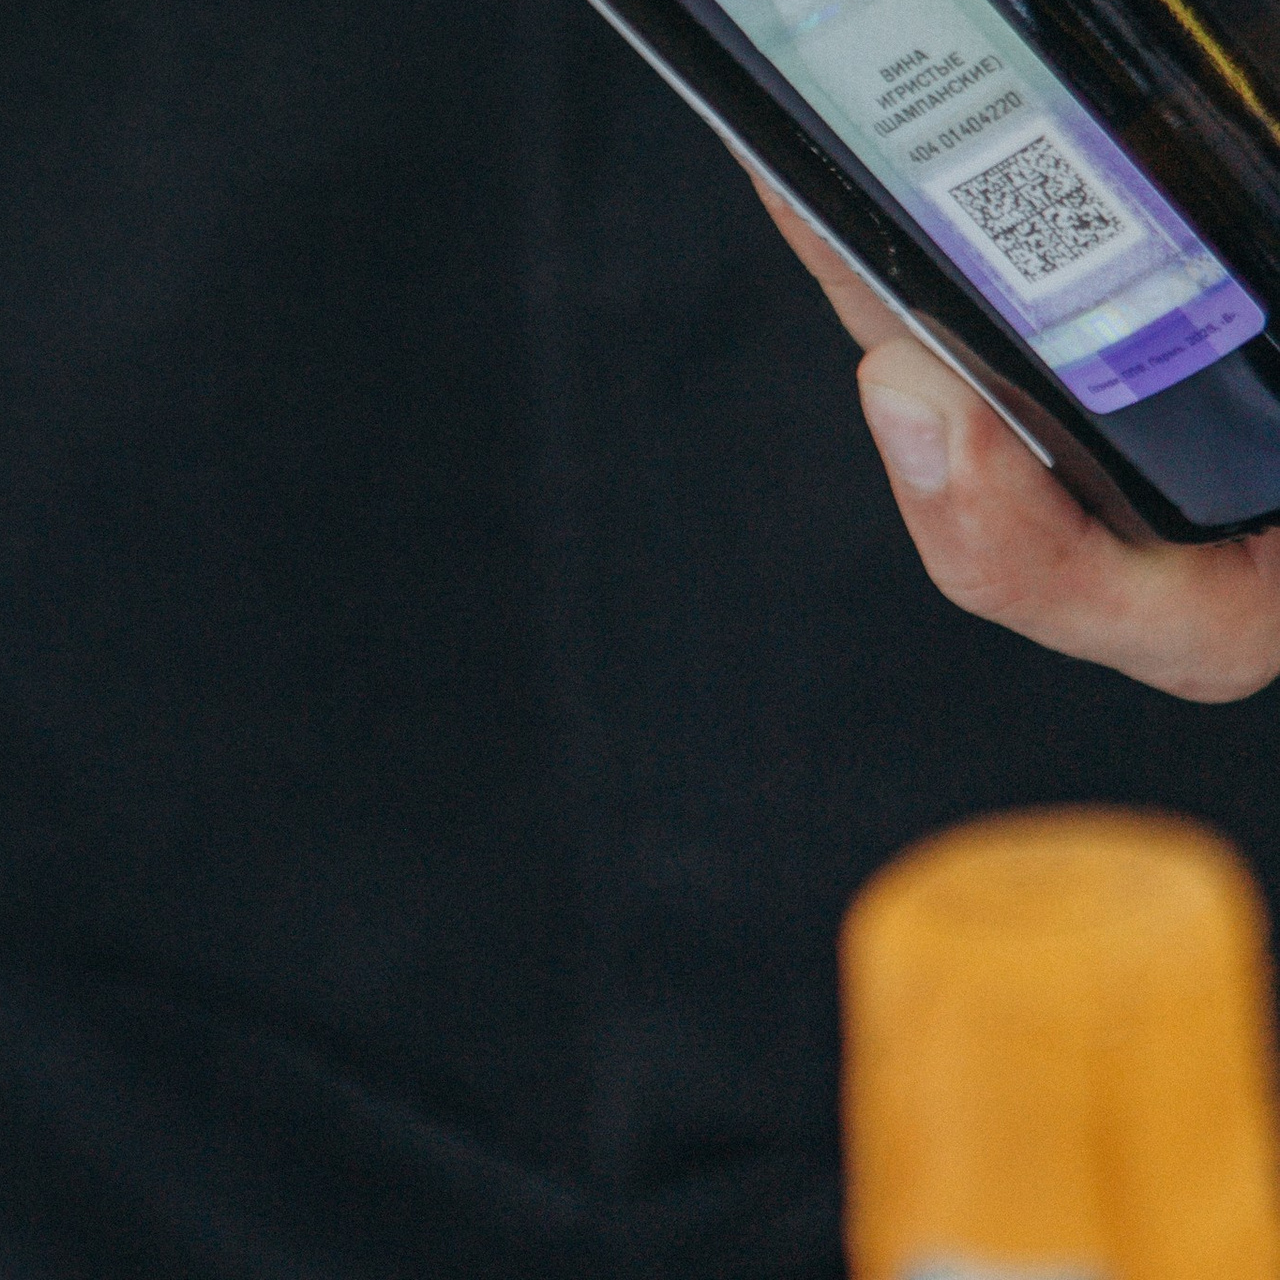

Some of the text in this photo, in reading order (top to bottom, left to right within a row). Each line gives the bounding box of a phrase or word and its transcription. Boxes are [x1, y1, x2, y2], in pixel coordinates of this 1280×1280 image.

[873, 54, 1003, 137] (ШАМПАНСКИЕ)
[875, 51, 966, 110] ИГРИСТЫЕ
[879, 49, 930, 83] ВИНА
